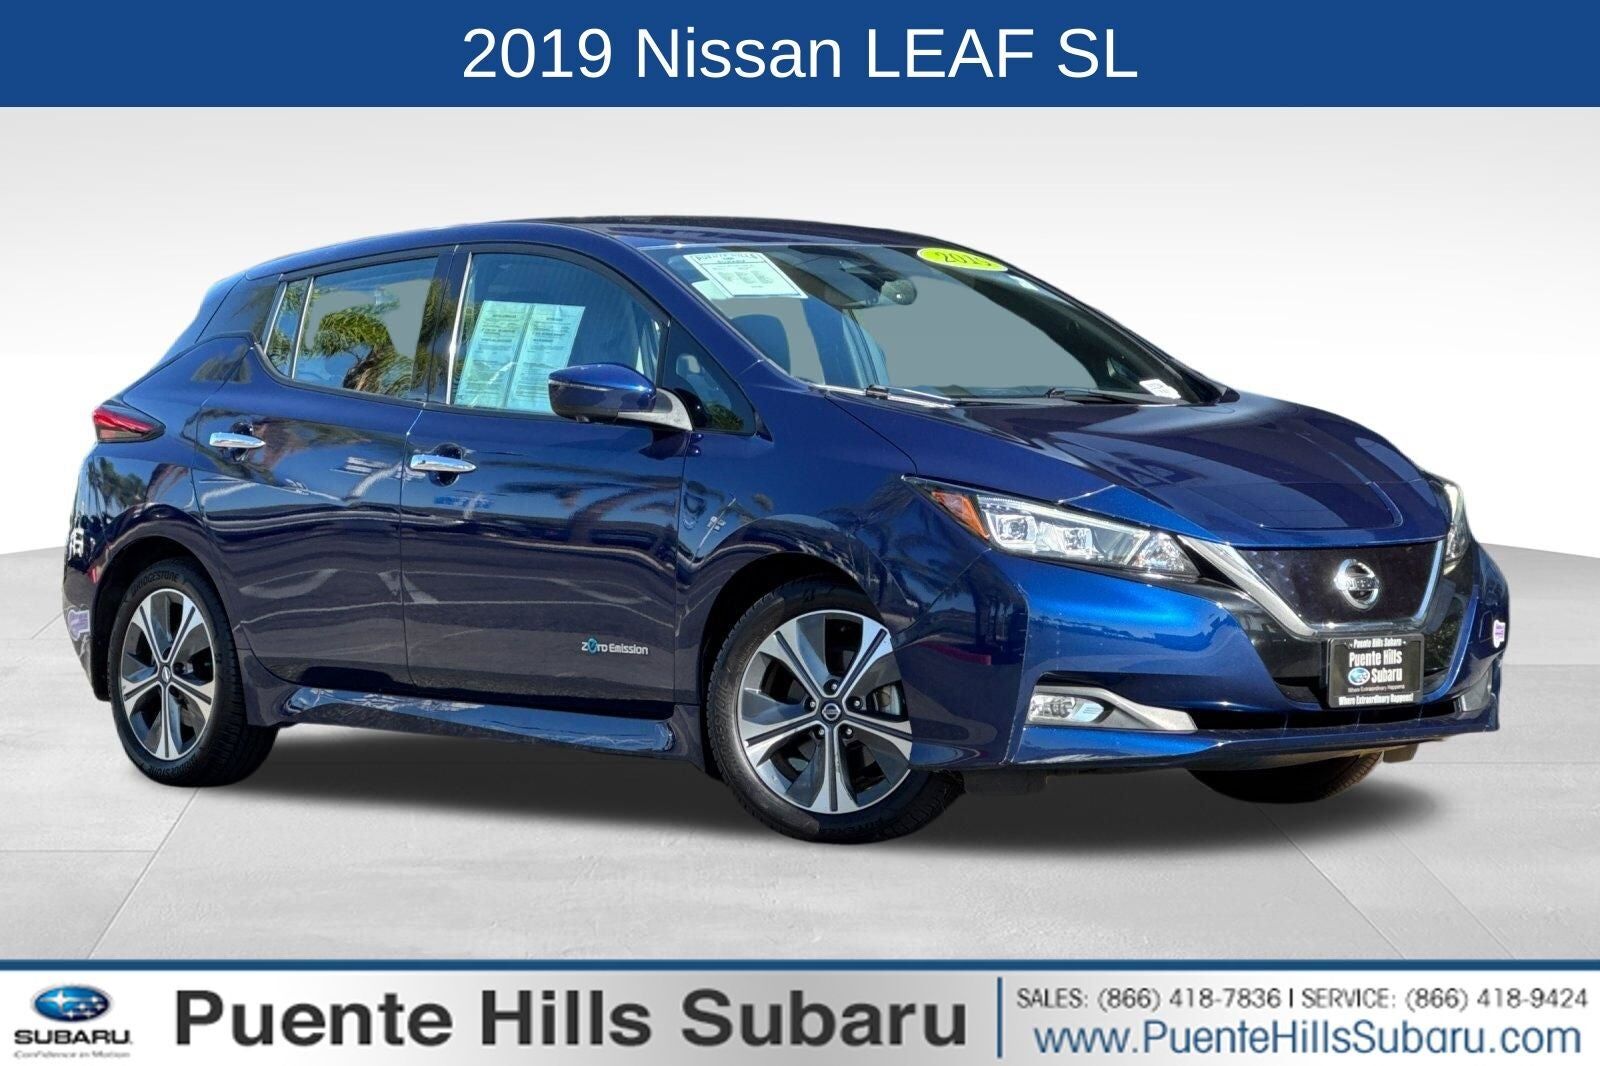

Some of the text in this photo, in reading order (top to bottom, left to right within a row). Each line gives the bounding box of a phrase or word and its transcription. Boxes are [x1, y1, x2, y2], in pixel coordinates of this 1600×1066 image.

[1353, 637, 1402, 648] Puente Hills Subaru
[608, 643, 649, 655] Emission
[1348, 648, 1403, 667] Puente Hills
[1371, 667, 1403, 683] Subaru
[1338, 696, 1356, 706] Where
[1356, 694, 1391, 706] Extraordinary
